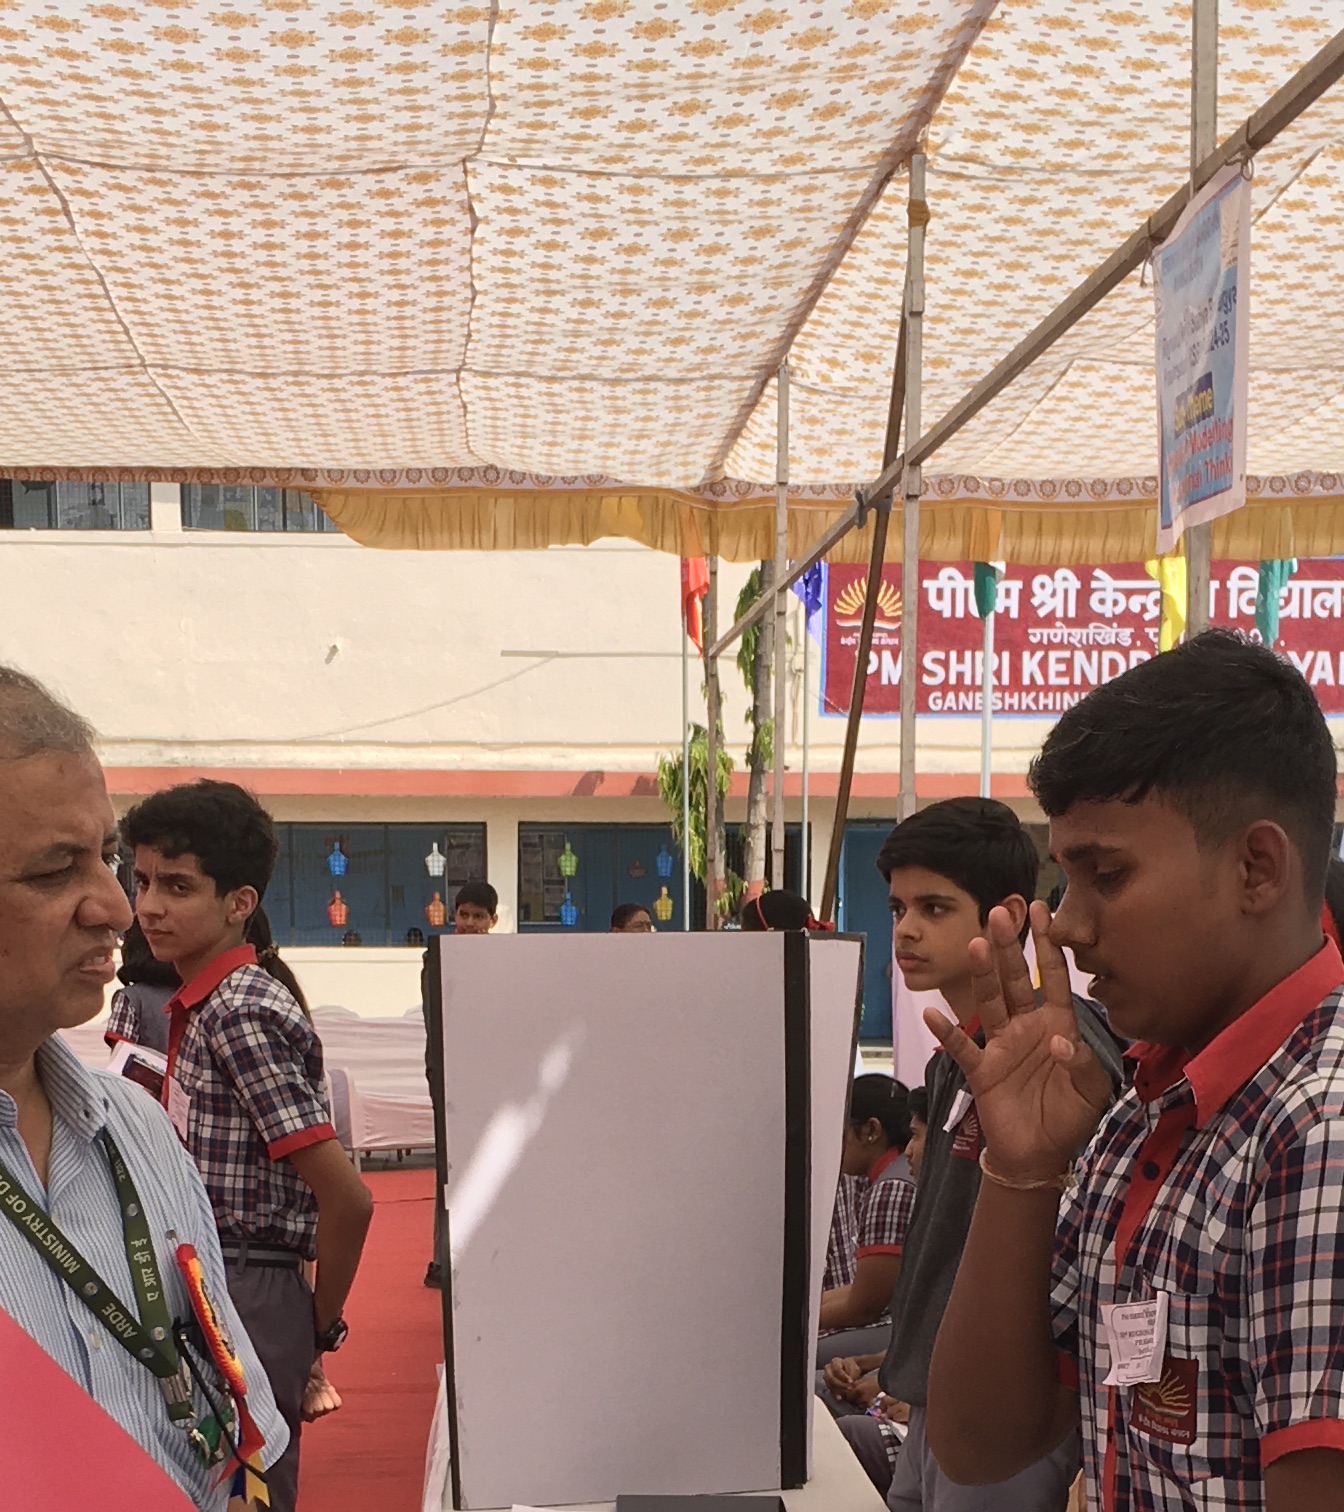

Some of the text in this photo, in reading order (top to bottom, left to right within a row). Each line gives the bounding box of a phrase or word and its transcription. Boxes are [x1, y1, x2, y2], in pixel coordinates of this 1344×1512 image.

[1029, 570, 1077, 620] श्री
[922, 650, 1010, 687] SHRI
[1022, 650, 1156, 686] KENDR
[4, 1188, 27, 1215] OF
[23, 1211, 81, 1275] MINISTRY
[101, 1303, 138, 1340] ARDE
